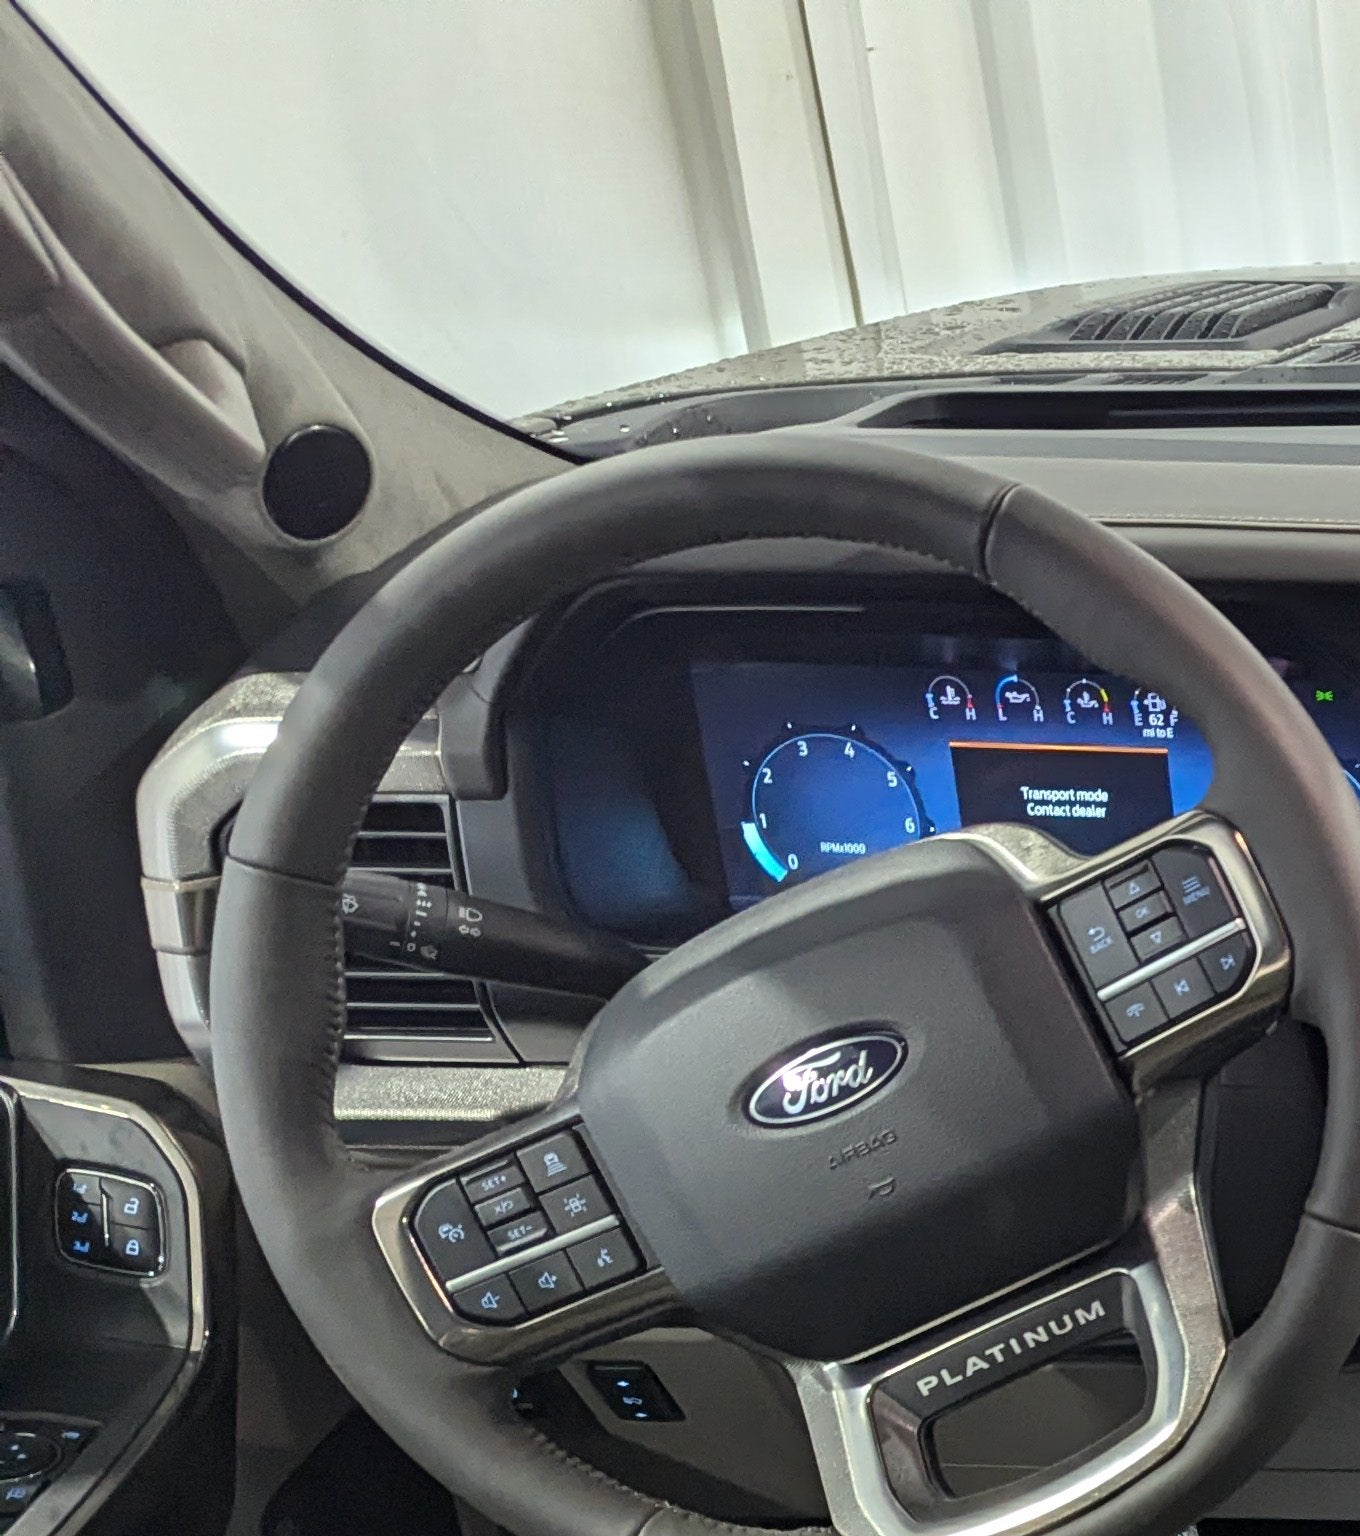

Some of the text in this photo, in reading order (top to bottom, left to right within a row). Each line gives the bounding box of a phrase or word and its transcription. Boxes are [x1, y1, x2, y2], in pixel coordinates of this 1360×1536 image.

[929, 706, 939, 720] C
[966, 708, 976, 720] H
[998, 709, 1007, 721] L
[1033, 708, 1044, 722] H
[1067, 711, 1076, 724] C
[1102, 712, 1113, 725] H
[1134, 714, 1143, 726] E
[1149, 714, 1164, 726] 62
[1170, 714, 1178, 726] F
[1143, 728, 1174, 738] mi to E
[797, 741, 808, 757] 3
[844, 742, 854, 758] 4
[762, 768, 772, 784] 2
[887, 771, 897, 788] 5
[1020, 786, 1109, 803] Transport mode
[1027, 803, 1106, 818] Contact dealer
[760, 813, 766, 829] 1
[905, 817, 915, 833] 6
[788, 854, 798, 870] 0
[782, 1050, 873, 1115] Ford
[828, 1128, 898, 1170] AIRBAG
[916, 1300, 1106, 1397] PLATINUM
